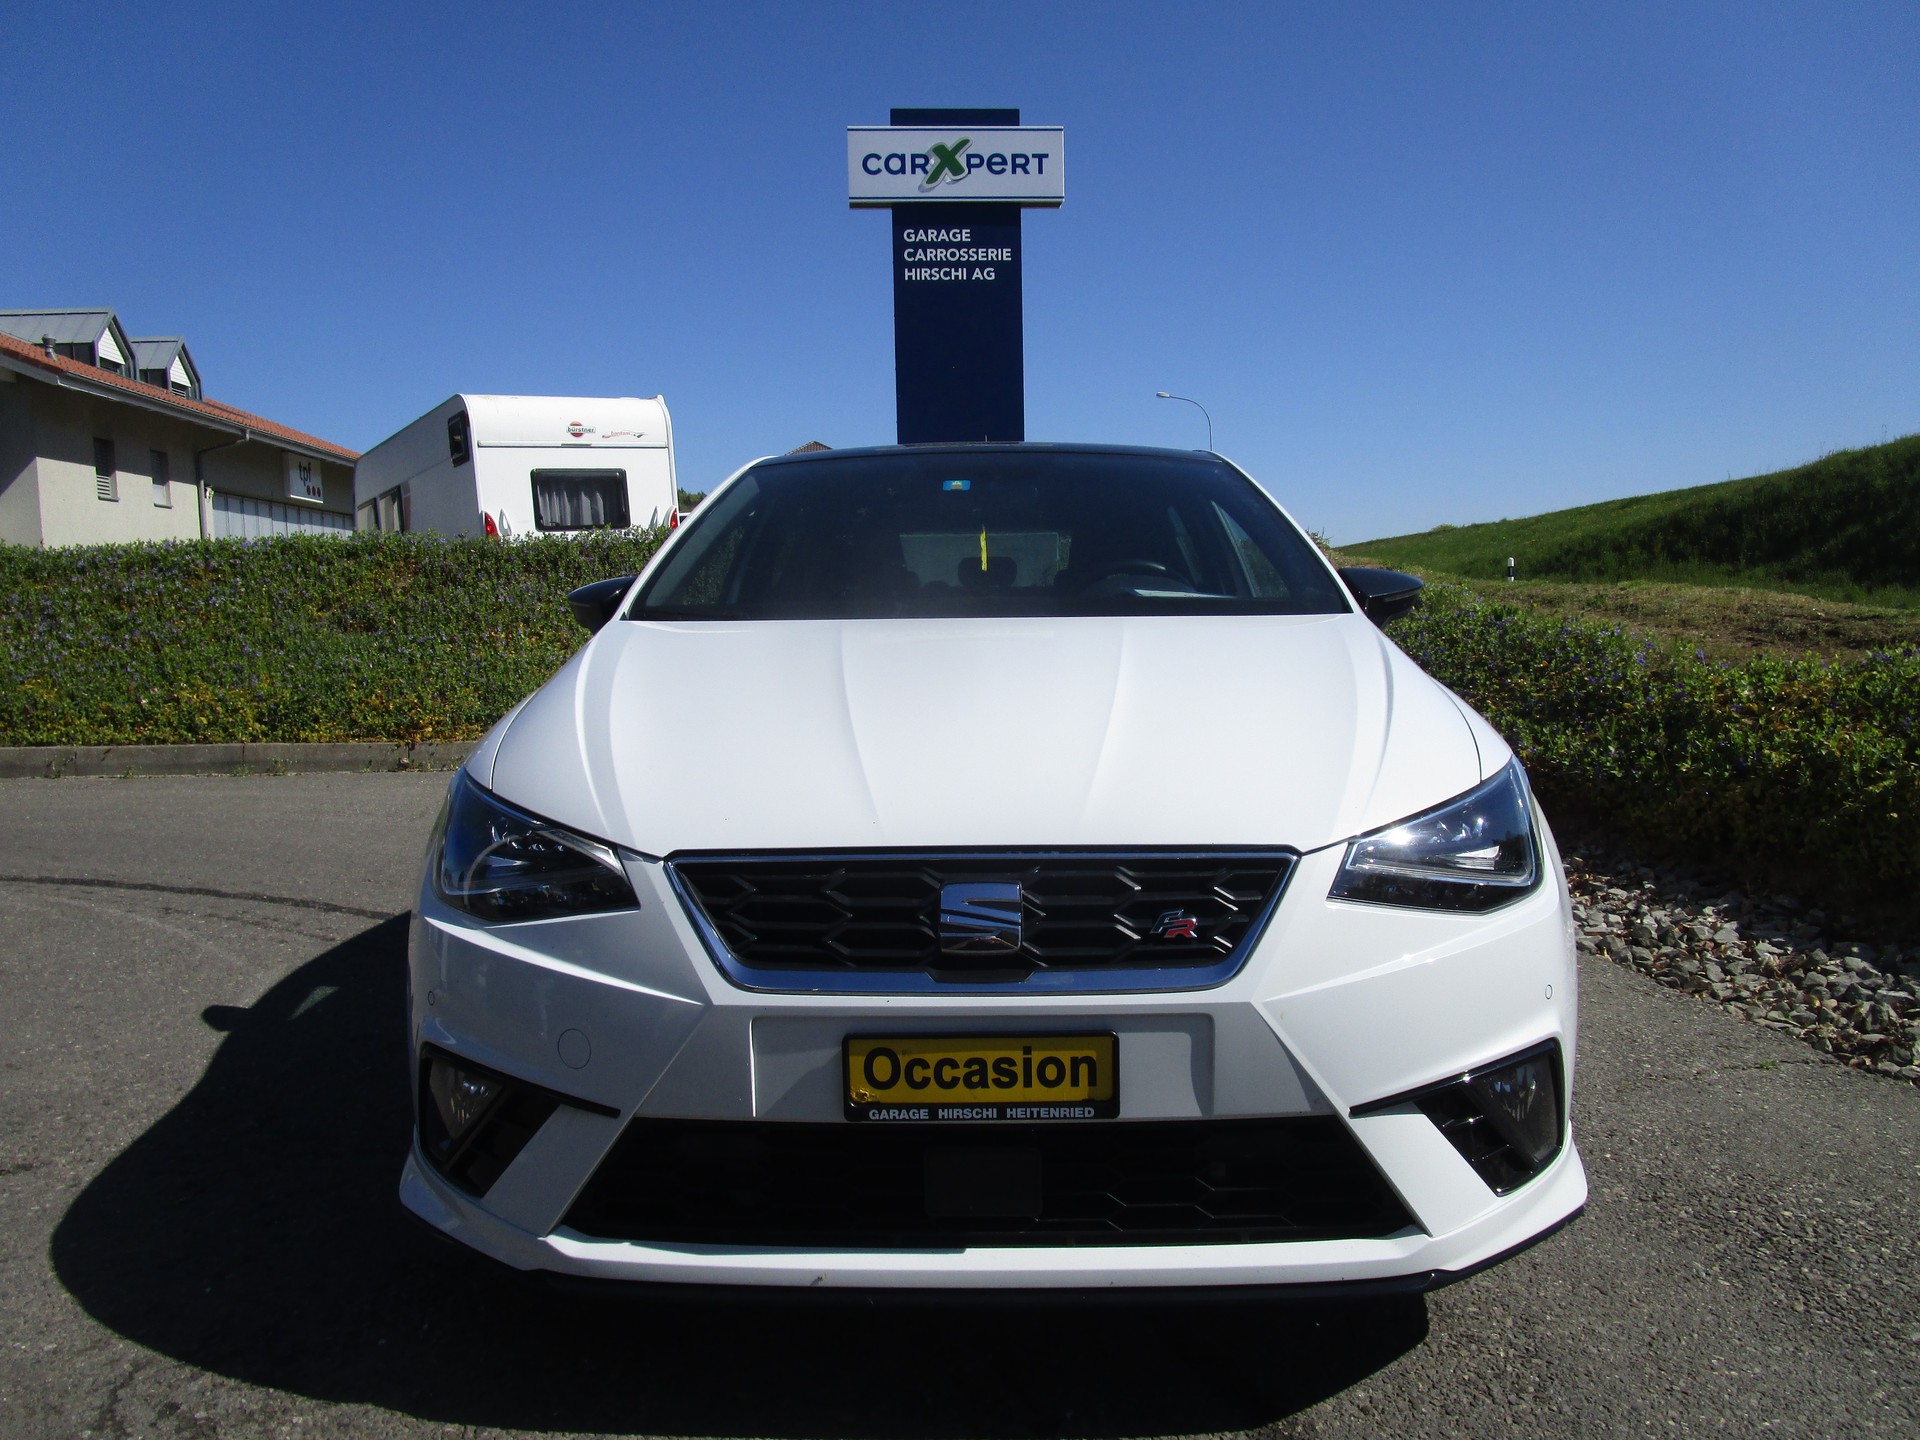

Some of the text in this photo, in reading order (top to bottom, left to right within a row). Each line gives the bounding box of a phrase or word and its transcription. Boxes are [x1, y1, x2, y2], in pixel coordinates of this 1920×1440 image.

[903, 228, 971, 243] GARAGE
[903, 248, 1012, 262] CARROSSERIE
[904, 267, 996, 281] HIRSCHI AG
[298, 461, 312, 487] tpf
[863, 1046, 1098, 1090] Occasion
[868, 1107, 1095, 1120] GARAGE HIRSCHI HEITENRIED
